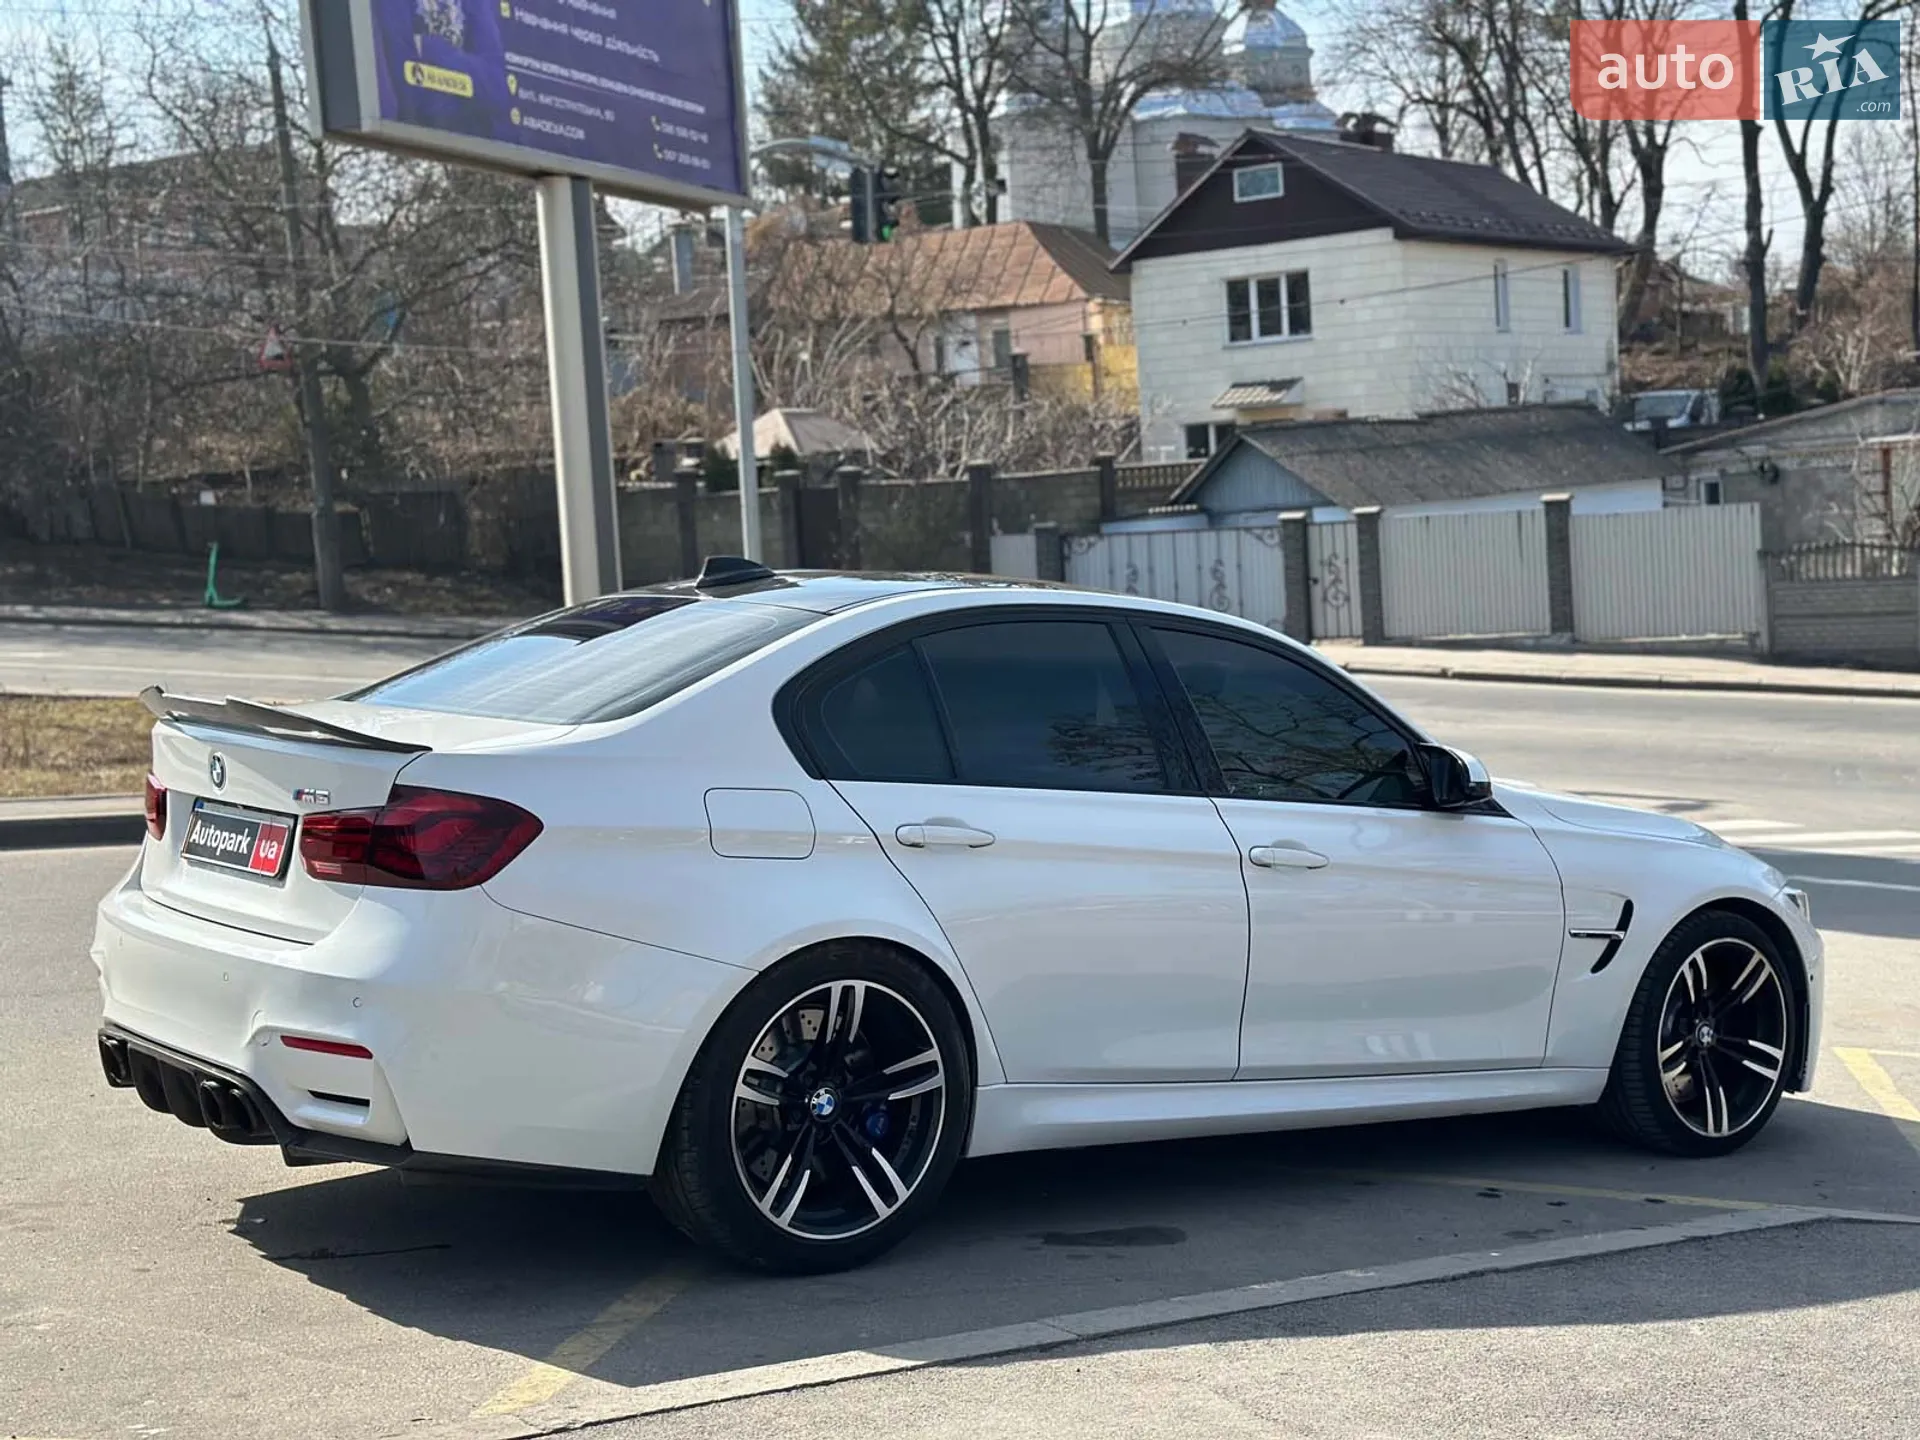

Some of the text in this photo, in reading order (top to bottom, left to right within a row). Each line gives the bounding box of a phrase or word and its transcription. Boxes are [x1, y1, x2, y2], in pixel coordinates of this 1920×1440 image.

[570, 26, 603, 46] через
[189, 819, 279, 859] Autopark ua
